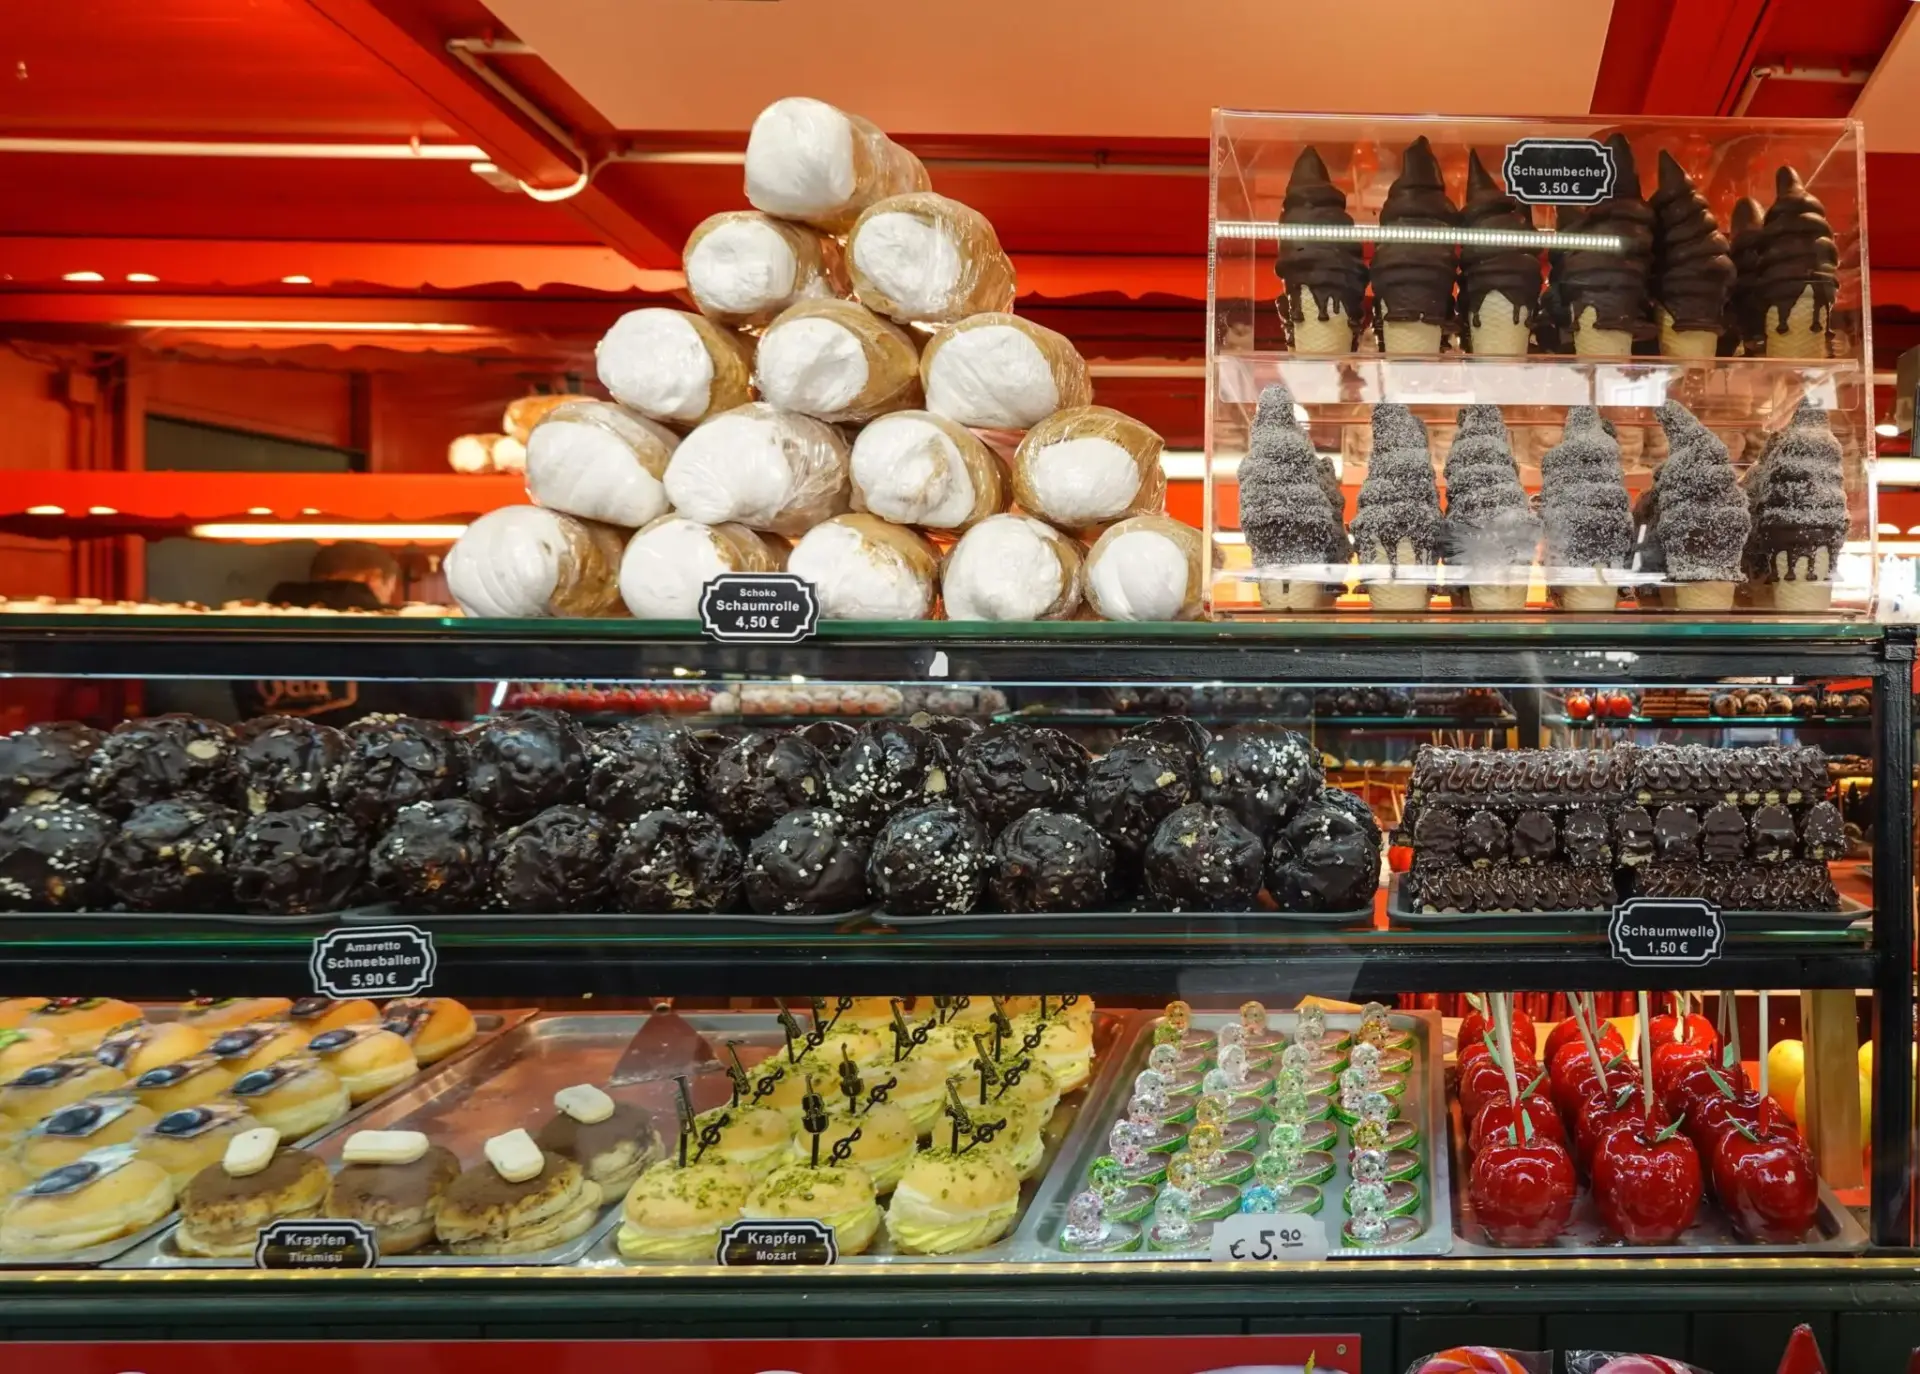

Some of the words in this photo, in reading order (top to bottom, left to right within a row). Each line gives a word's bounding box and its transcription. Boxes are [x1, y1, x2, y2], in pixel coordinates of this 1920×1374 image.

[1513, 165, 1606, 178] Schaumbecher
[1540, 182, 1569, 195] 3,50
[1571, 182, 1580, 194] €
[739, 588, 778, 597] Schoko
[716, 600, 800, 612] Schaumrolle
[735, 616, 768, 630] 4,50
[770, 616, 780, 628] €
[1621, 924, 1715, 938] Schaumwelle
[345, 941, 402, 952] Amaretto
[1647, 941, 1677, 955] 1,50
[1679, 941, 1689, 954] €
[327, 954, 421, 969] Schneeballen
[351, 973, 384, 987] 5,90
[387, 972, 397, 985] €
[285, 1233, 346, 1248] Krapfen
[747, 1232, 807, 1247] Krapfen
[756, 1251, 797, 1261] Mozart
